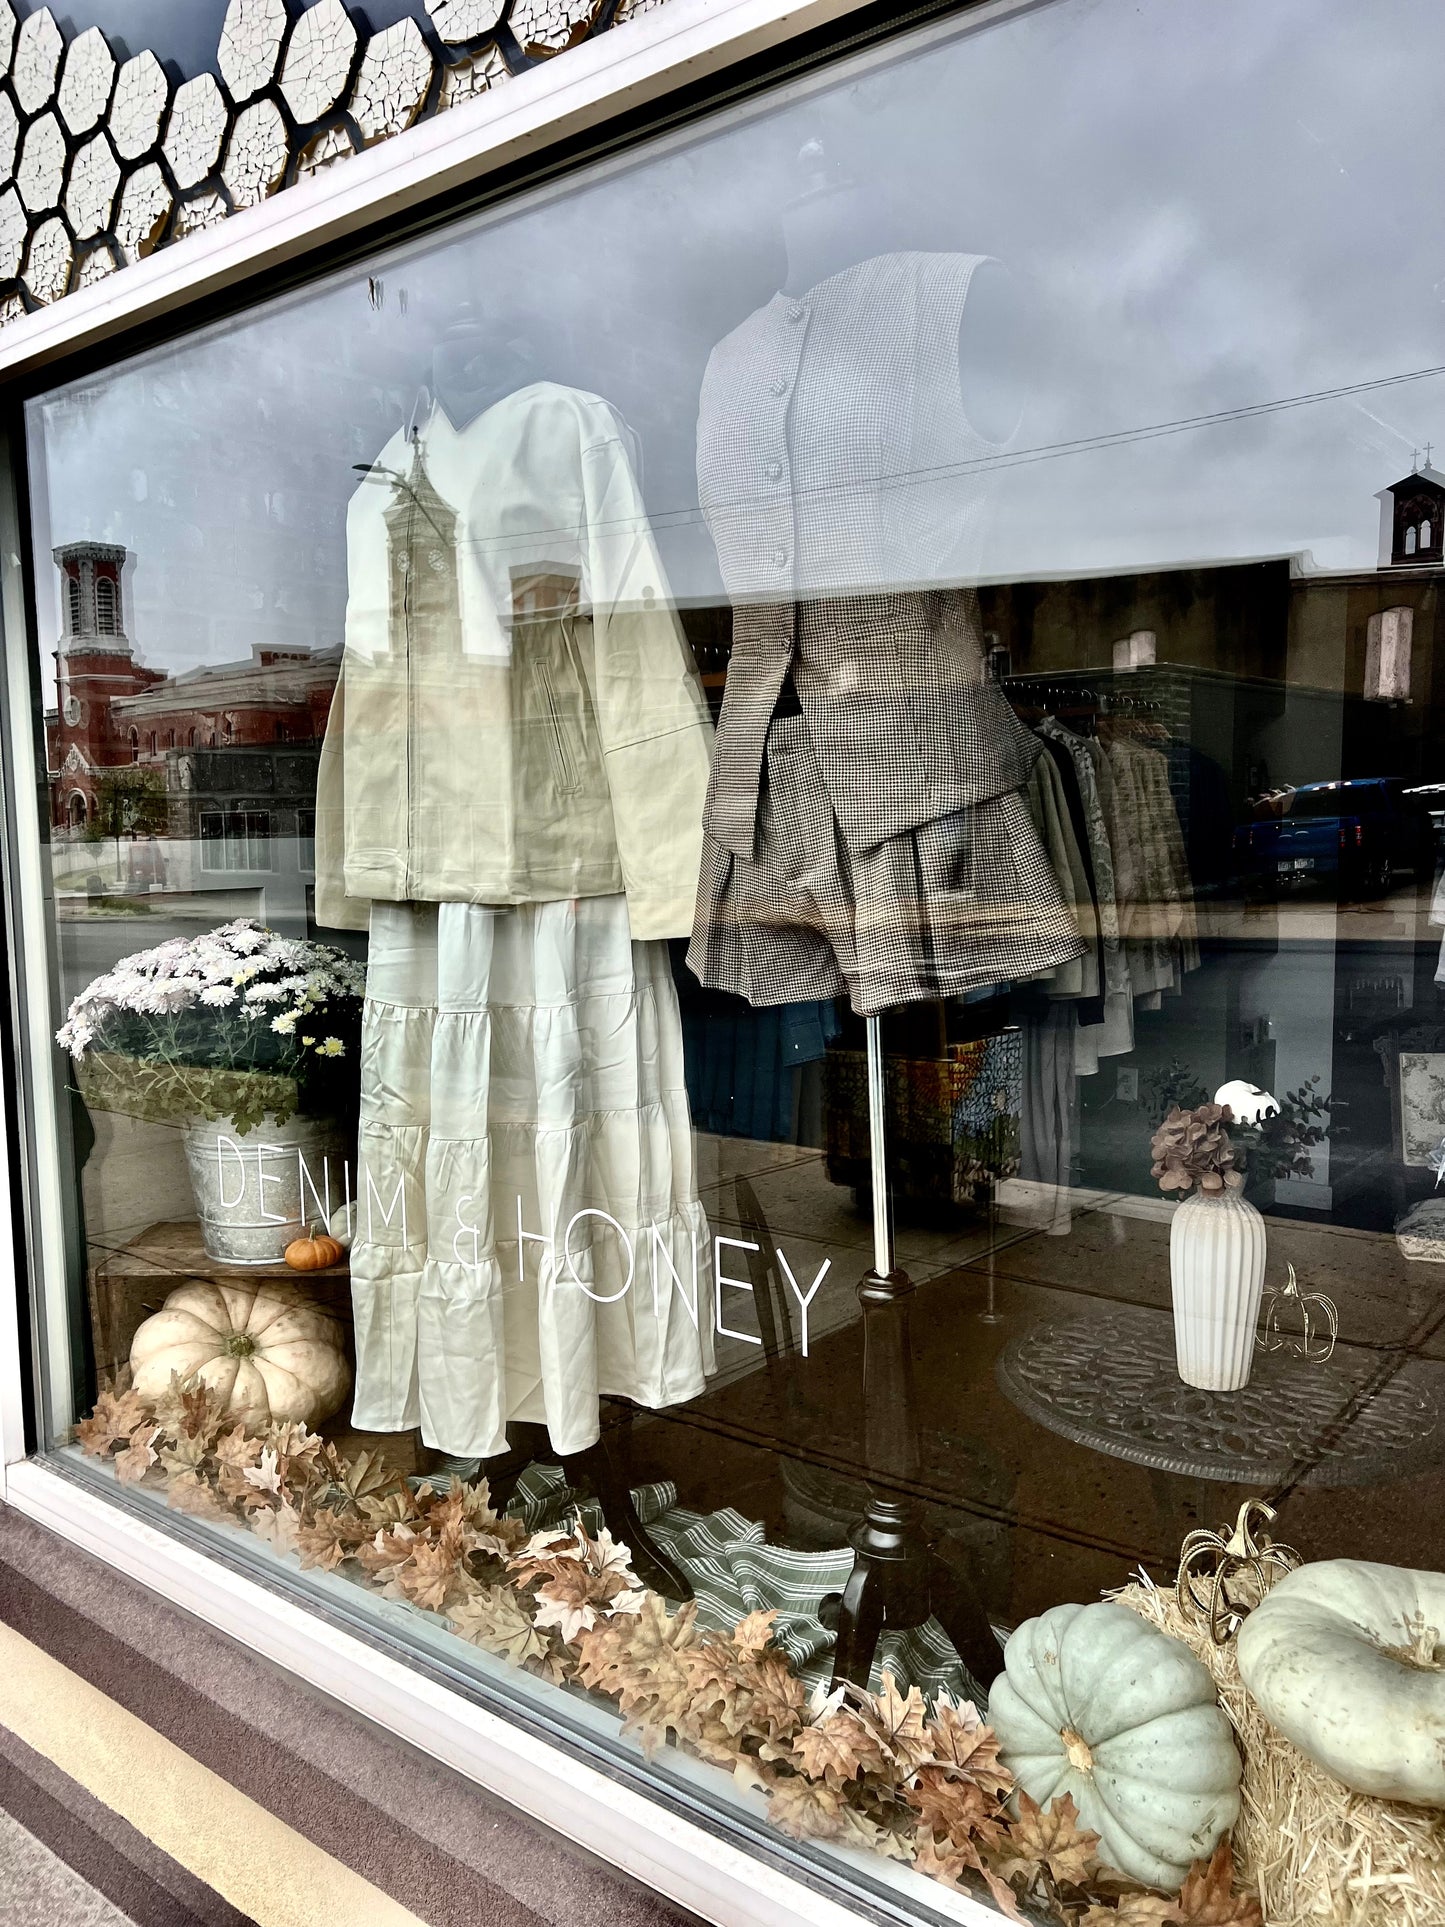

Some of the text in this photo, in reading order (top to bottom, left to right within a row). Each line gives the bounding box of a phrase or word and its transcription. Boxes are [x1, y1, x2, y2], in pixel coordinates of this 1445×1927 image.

[217, 1135, 832, 1358] DENIM & HONEY
